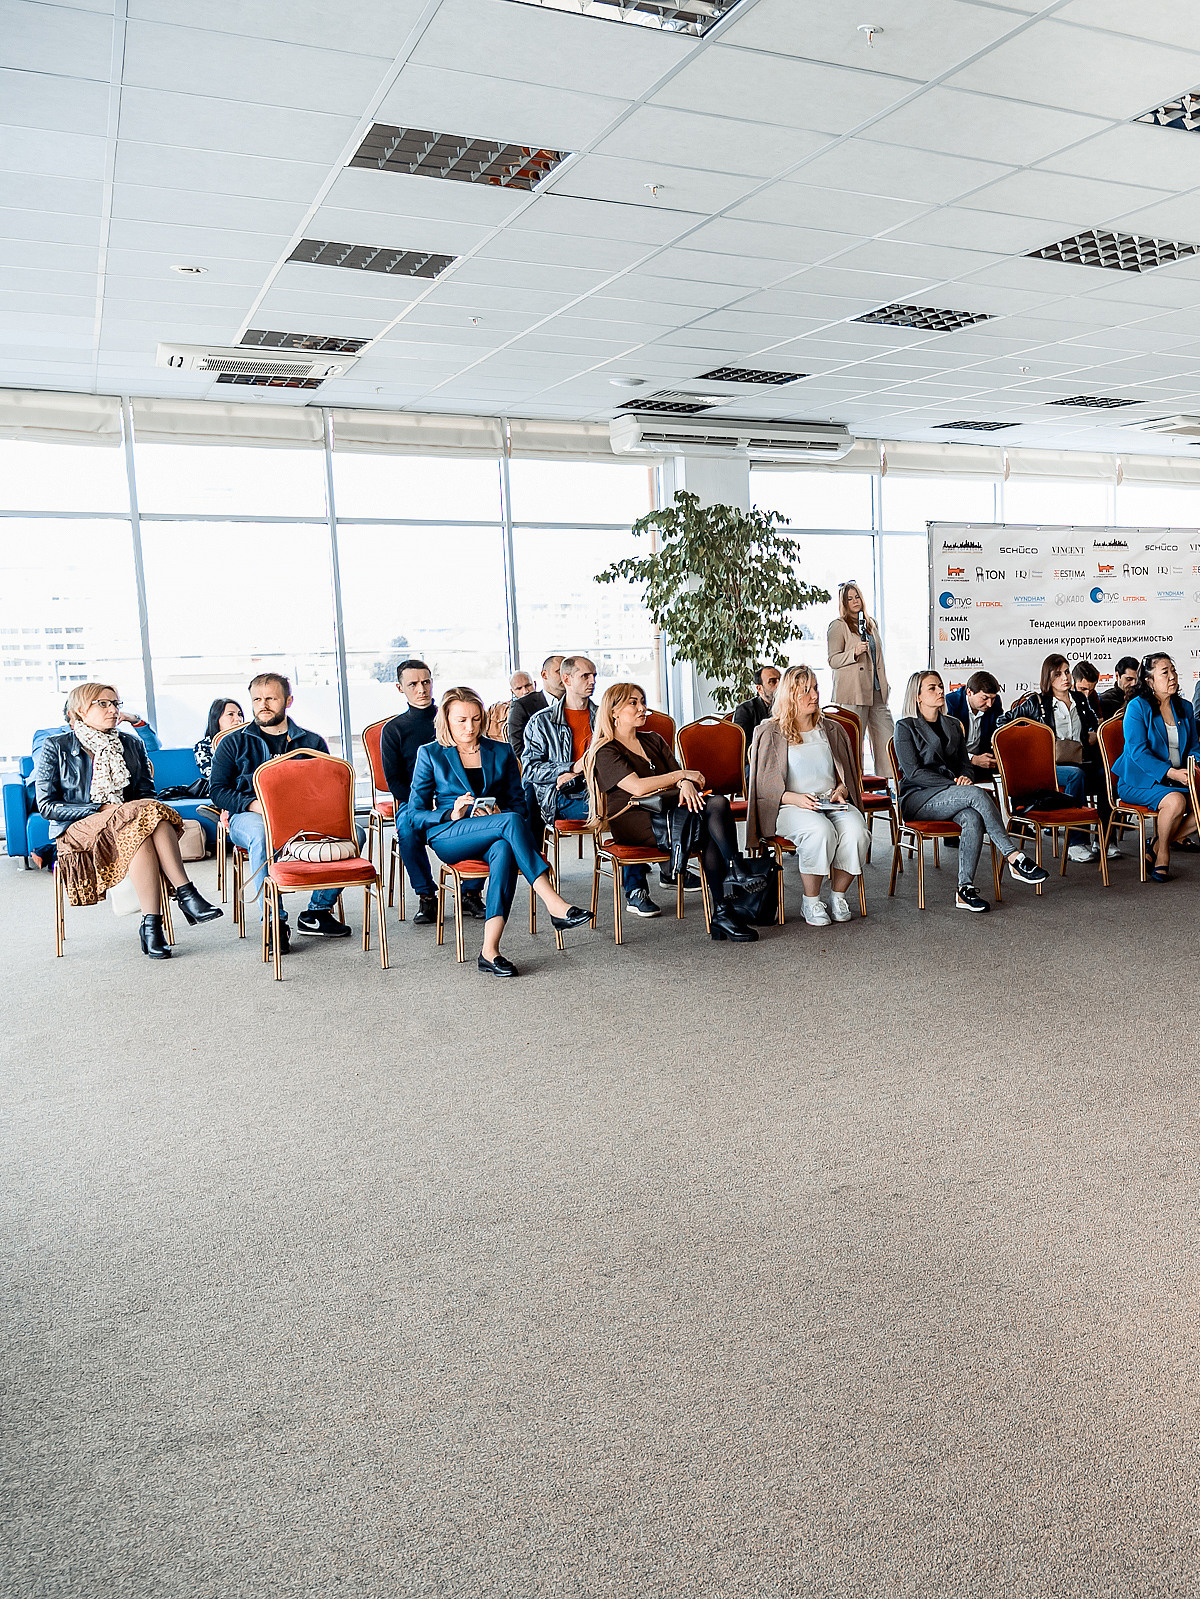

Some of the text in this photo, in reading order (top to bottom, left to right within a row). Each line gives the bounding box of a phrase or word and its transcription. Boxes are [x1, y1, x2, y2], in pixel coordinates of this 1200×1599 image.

[999, 545, 1039, 554] SCHÜCO
[1051, 546, 1085, 554] VINCENT
[985, 570, 1006, 580] TON
[1060, 569, 1085, 578] ESTIMA
[1131, 566, 1149, 576] TON
[1029, 618, 1146, 629] Тенденции проектирования
[950, 627, 970, 641] SWG
[999, 635, 1174, 648] и управления курортной недвижимостью
[1066, 651, 1092, 661] СОЧИ
